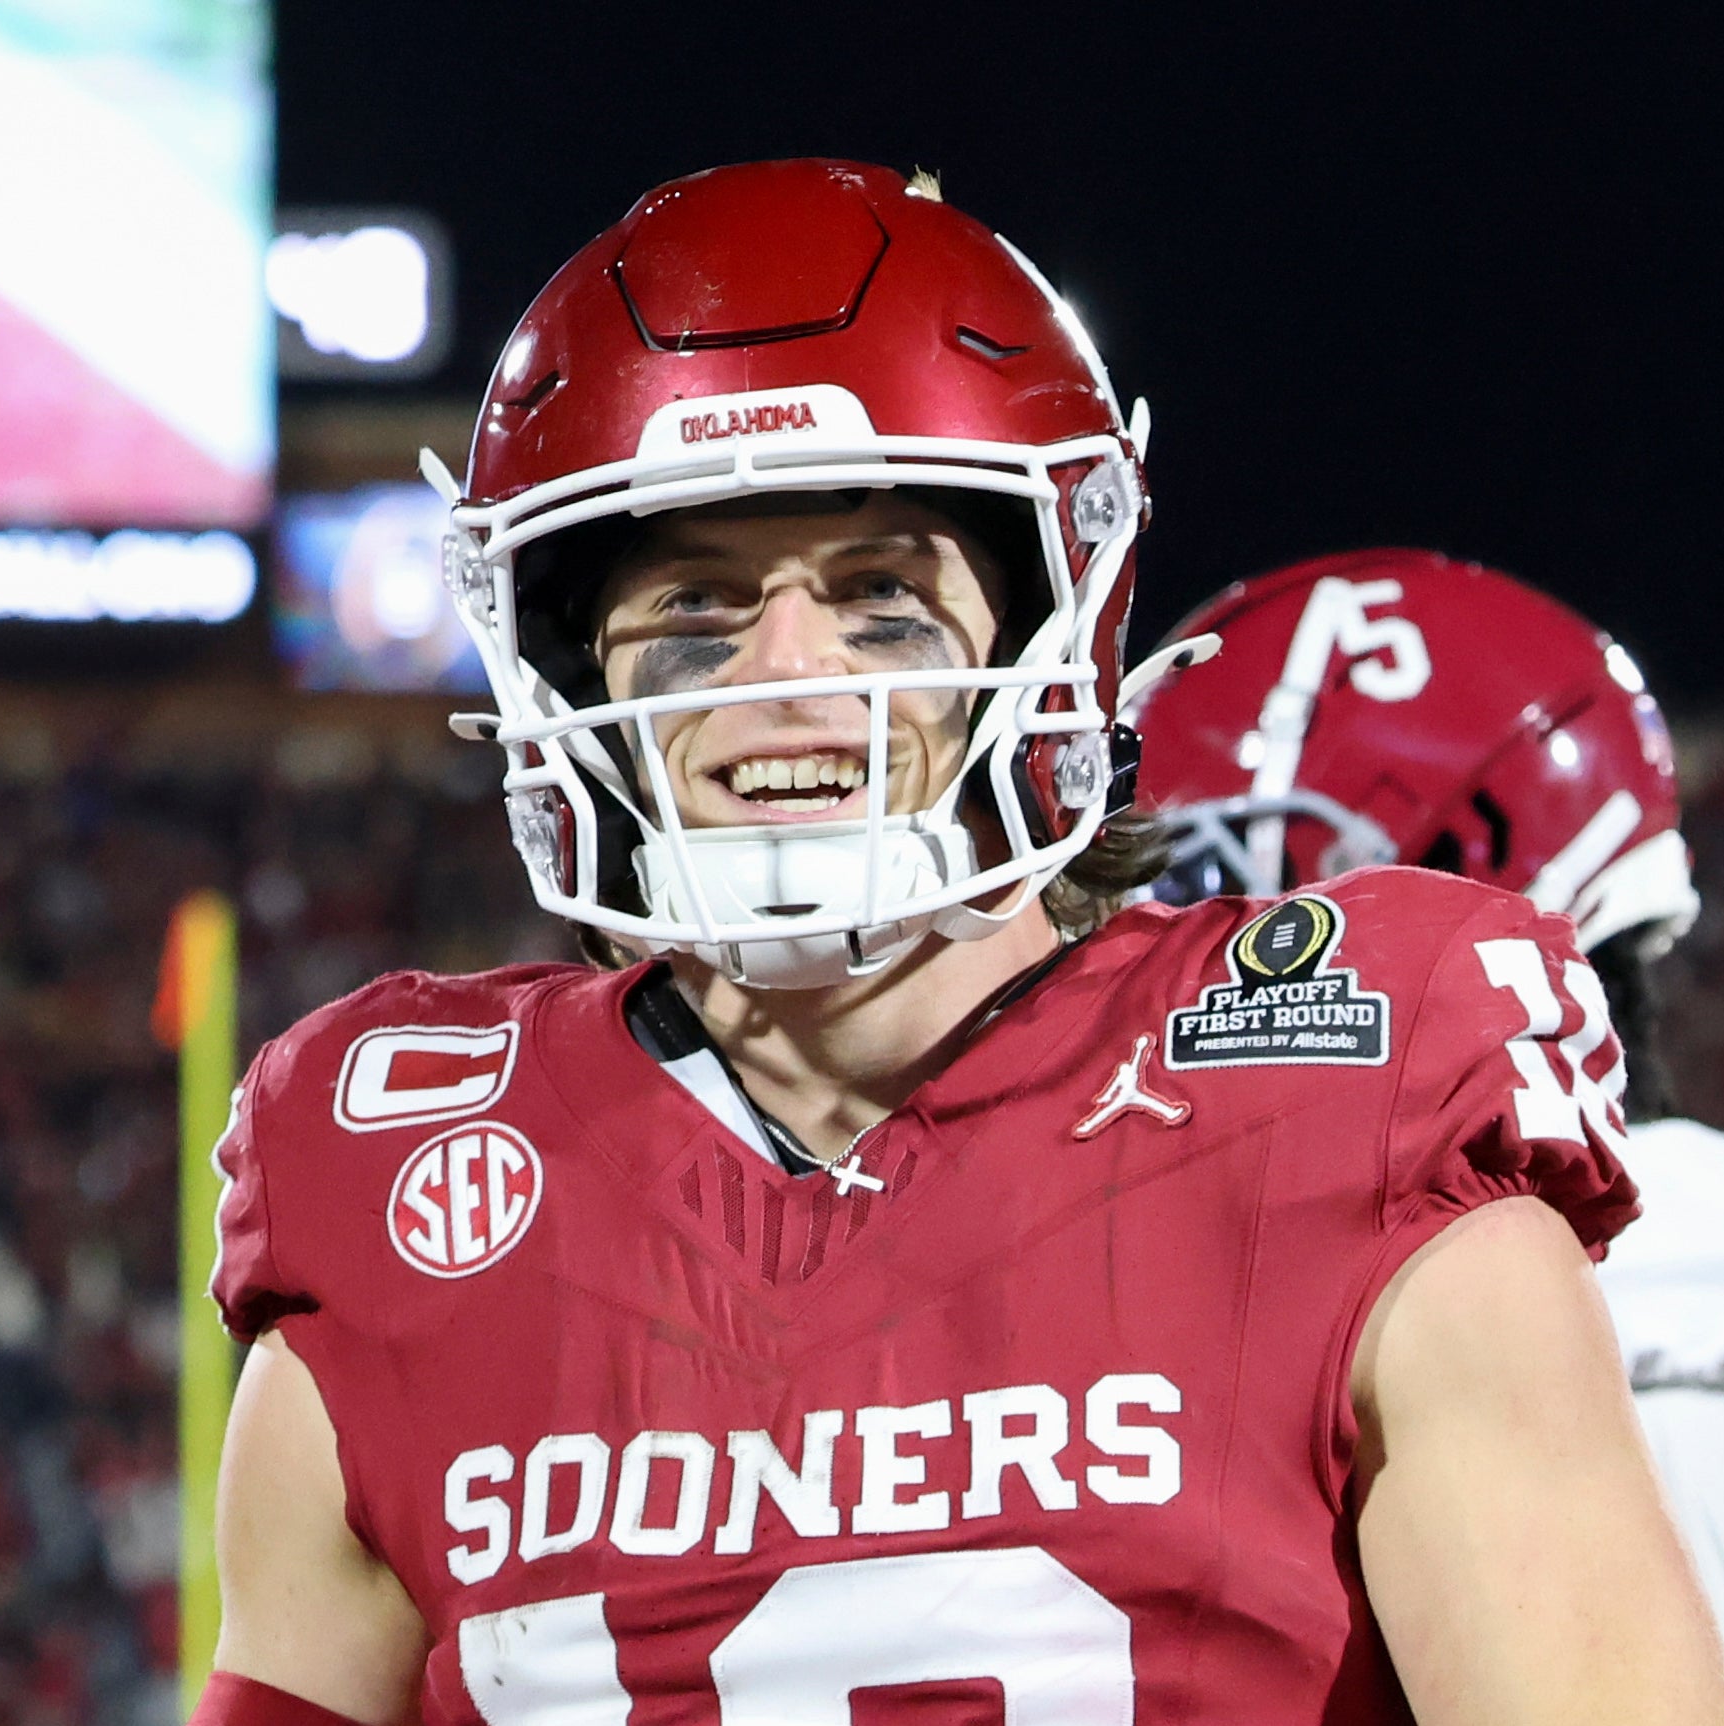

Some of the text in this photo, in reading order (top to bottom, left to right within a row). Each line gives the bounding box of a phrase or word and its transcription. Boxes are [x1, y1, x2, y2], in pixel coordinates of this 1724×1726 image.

[681, 402, 817, 444] OKLAHOMA
[1336, 577, 1433, 702] 5
[1178, 1003, 1375, 1036] FIRST ROUND
[1212, 978, 1343, 1012] PLAYOFF
[341, 1026, 511, 1119] C
[1194, 1031, 1359, 1052] PRESENTED BY Allstate
[402, 1133, 527, 1264] SEC
[444, 1373, 1181, 1585] SOONERS
